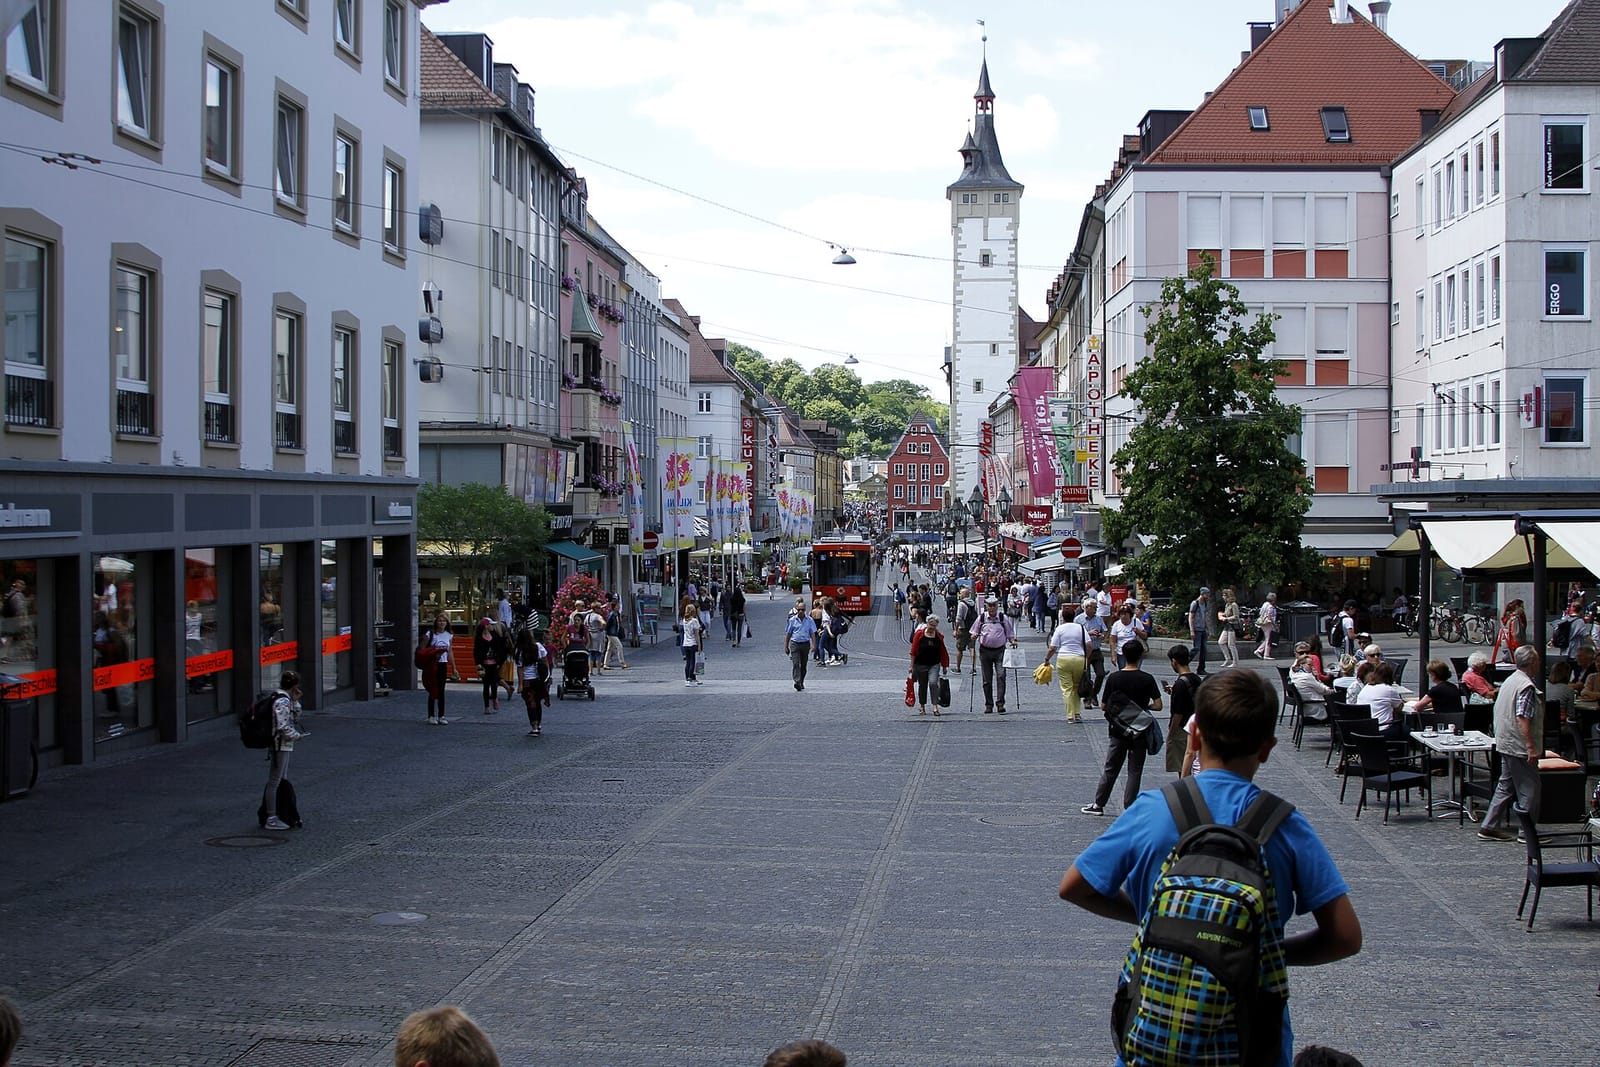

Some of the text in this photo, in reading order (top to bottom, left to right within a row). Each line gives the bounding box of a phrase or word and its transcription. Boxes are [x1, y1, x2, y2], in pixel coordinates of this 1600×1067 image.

[1550, 283, 1560, 314] ERGO
[1088, 353, 1101, 488] APOTHEKE
[1027, 511, 1047, 519] Schlier
[1196, 931, 1221, 943] ASPEN
